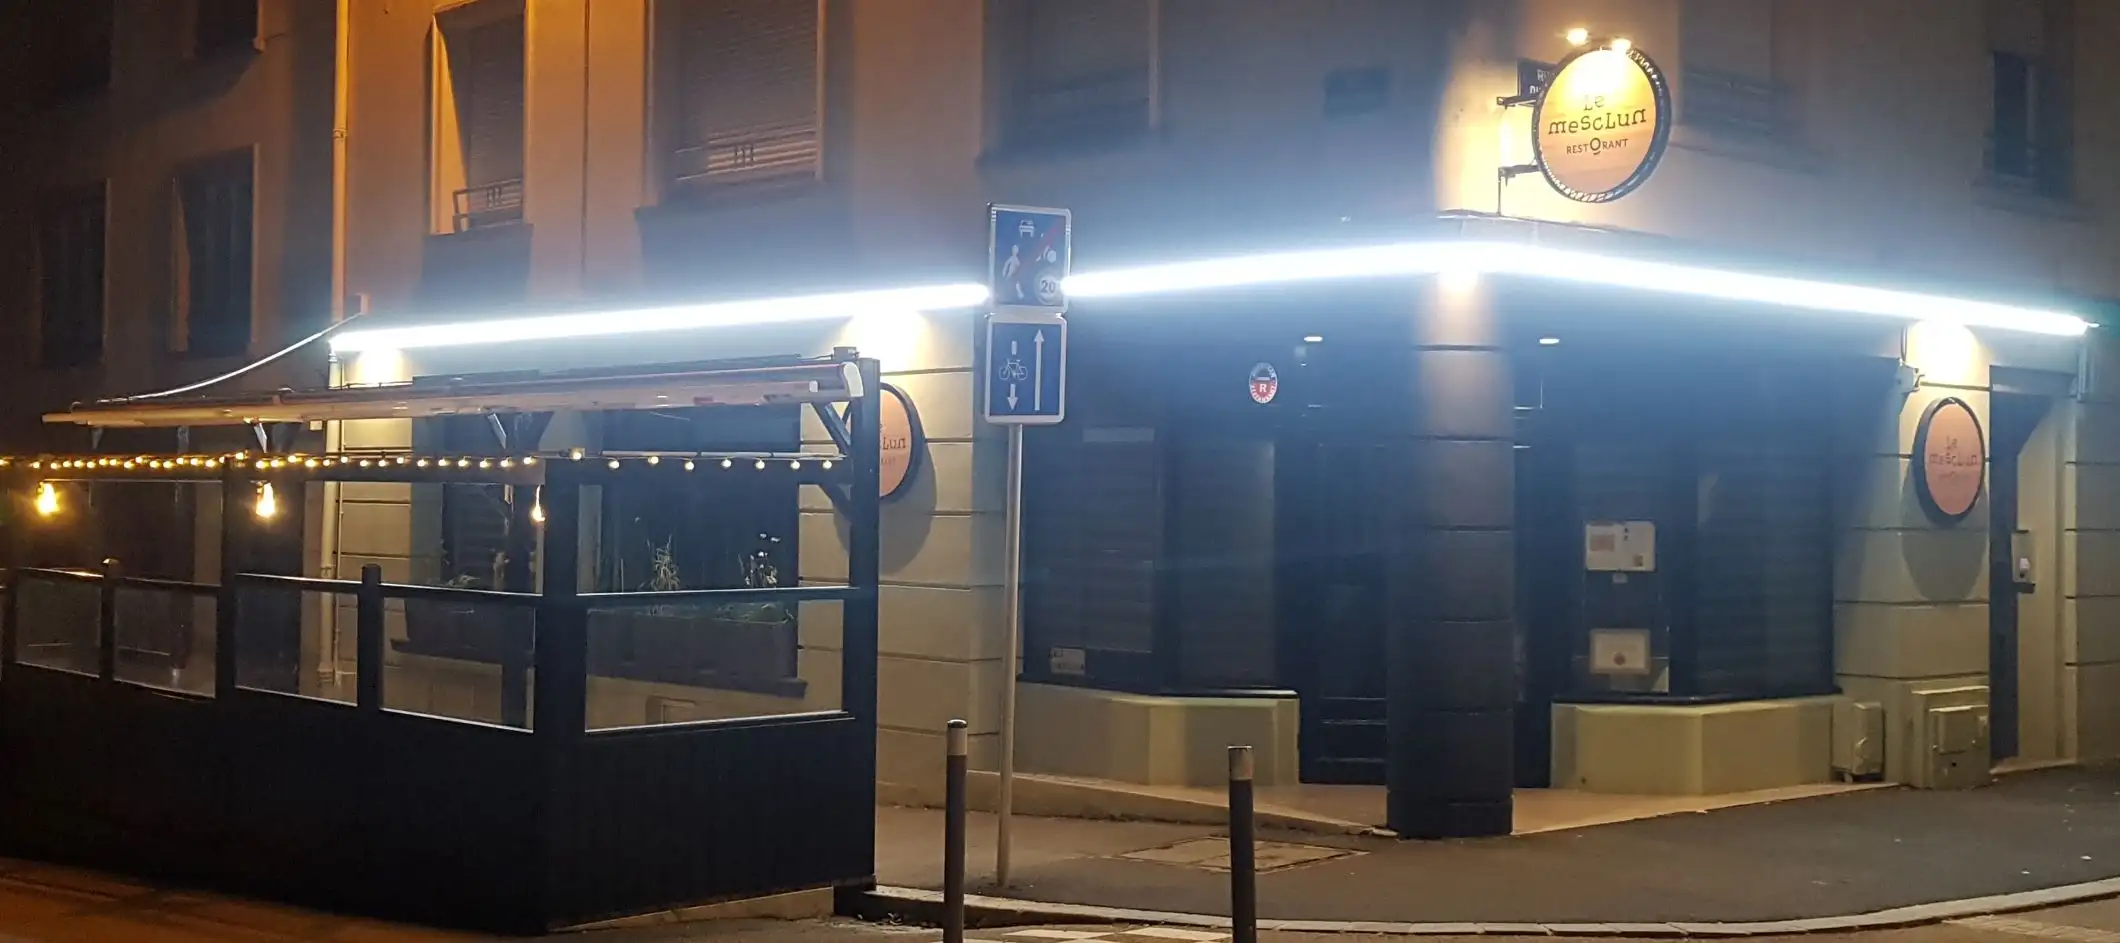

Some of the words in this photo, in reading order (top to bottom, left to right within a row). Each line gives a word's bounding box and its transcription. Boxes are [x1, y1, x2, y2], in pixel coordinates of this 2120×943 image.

[1583, 94, 1605, 112] Le
[1566, 137, 1630, 156] RESTORANT
[1041, 279, 1056, 294] 20
[1259, 383, 1268, 393] R
